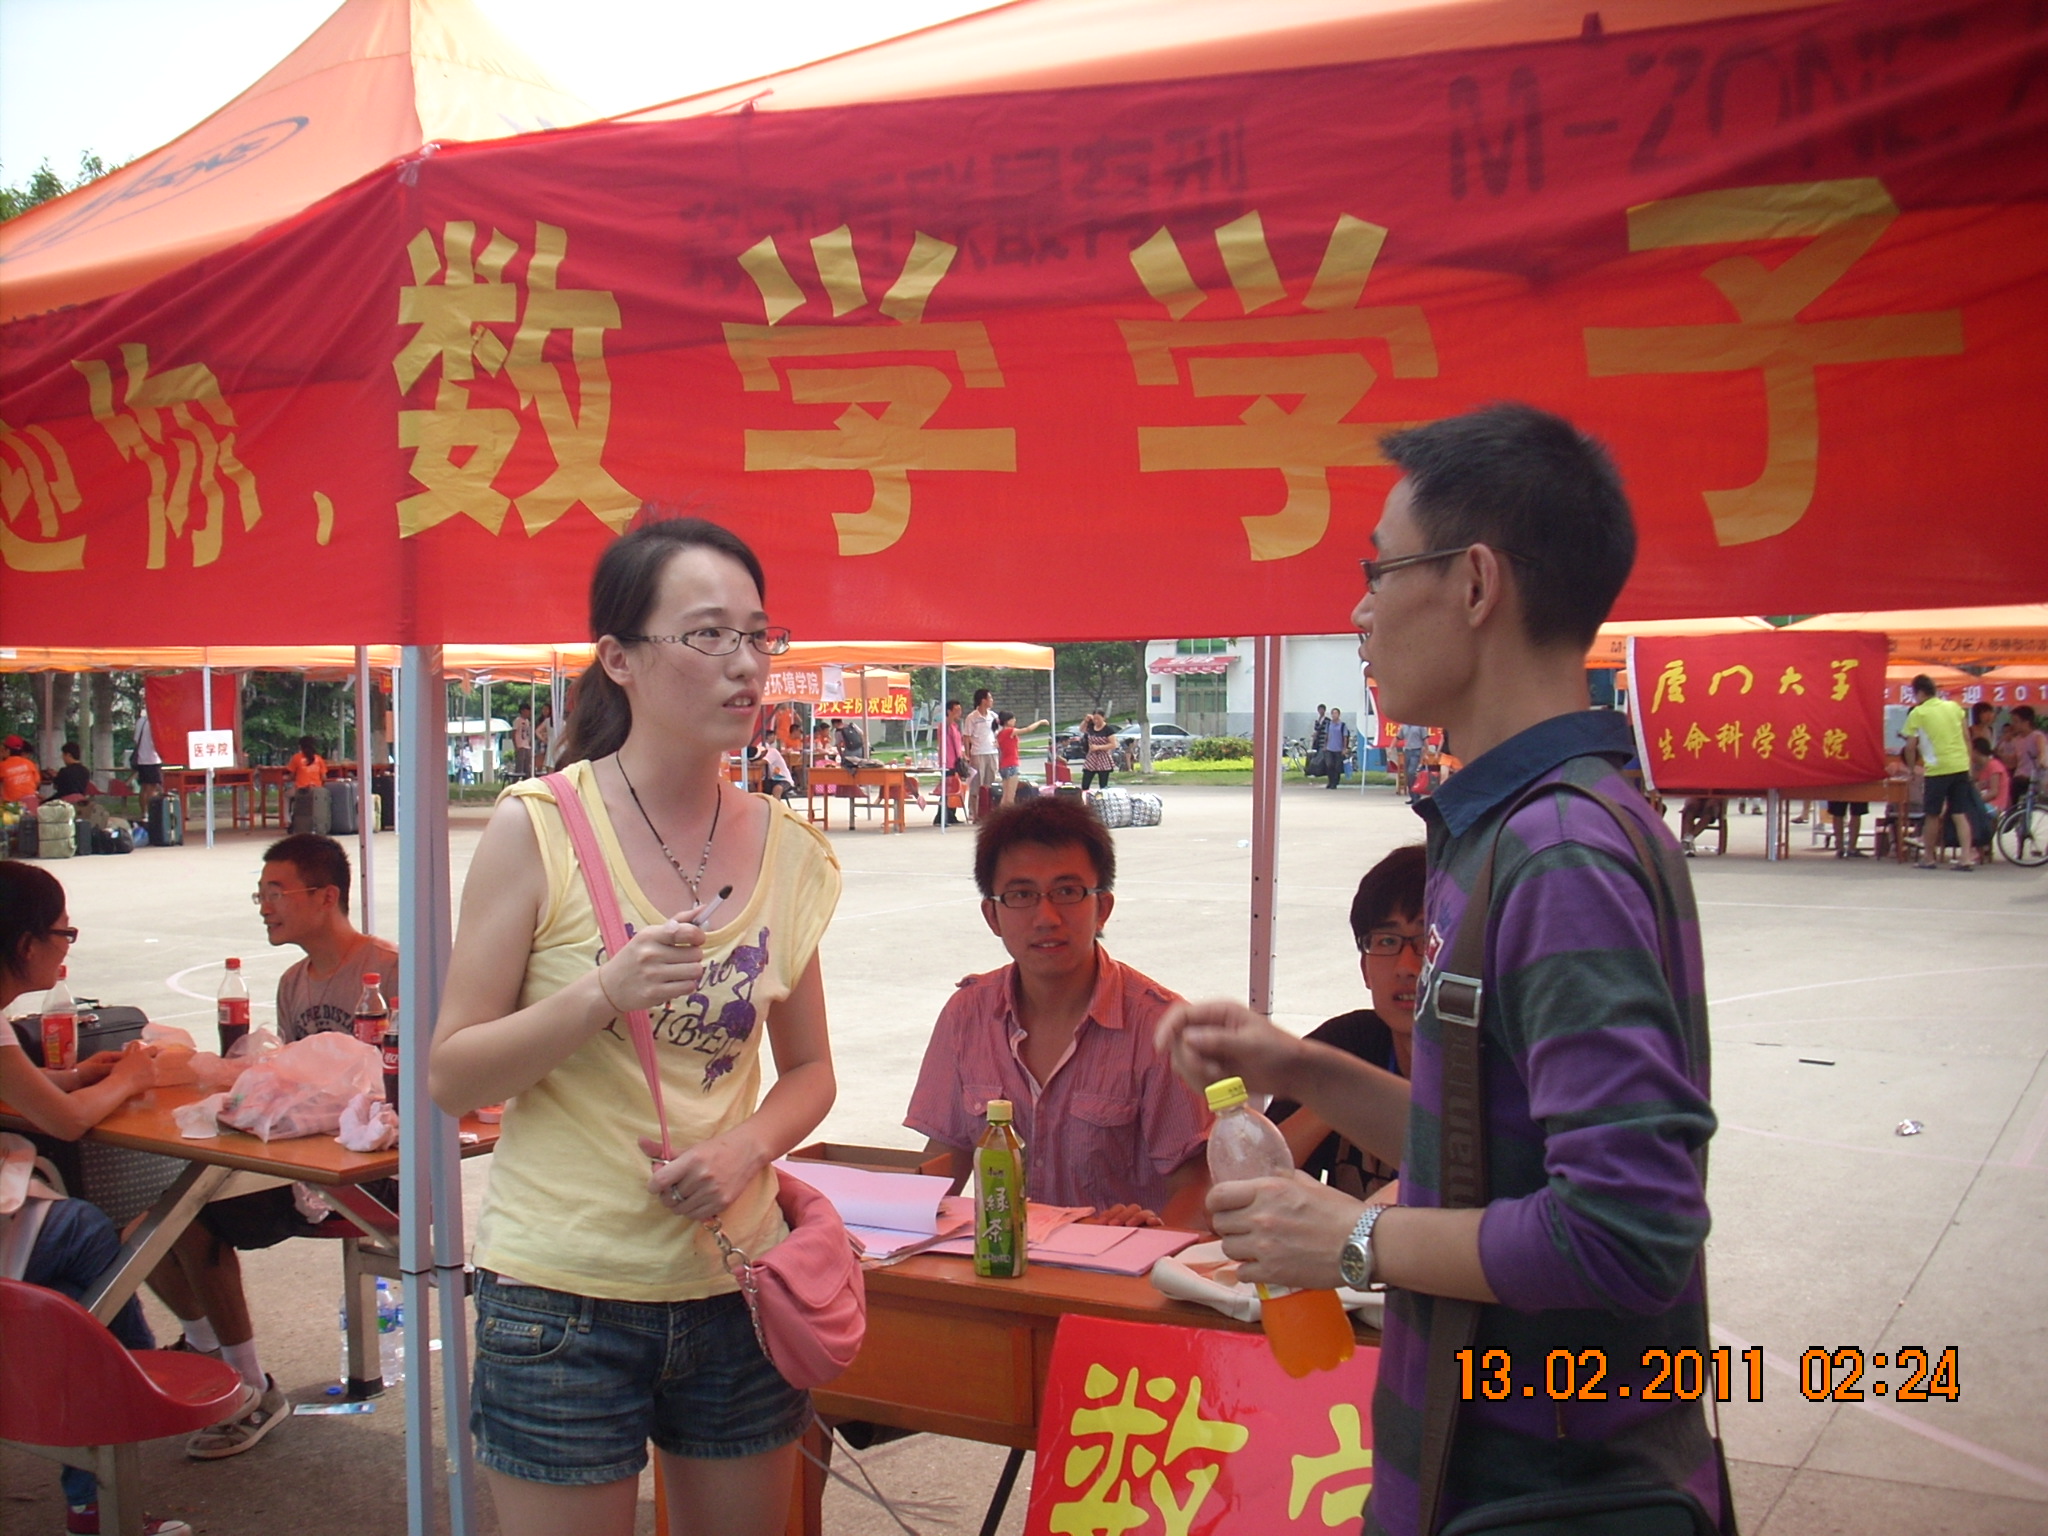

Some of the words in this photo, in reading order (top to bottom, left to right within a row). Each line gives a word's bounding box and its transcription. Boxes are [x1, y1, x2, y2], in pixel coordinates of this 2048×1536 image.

[392, 177, 1965, 561] 数学学子
[1651, 659, 1859, 714] 厦门大学
[193, 742, 229, 758] 医学院
[1658, 720, 1851, 760] 生命科学学院
